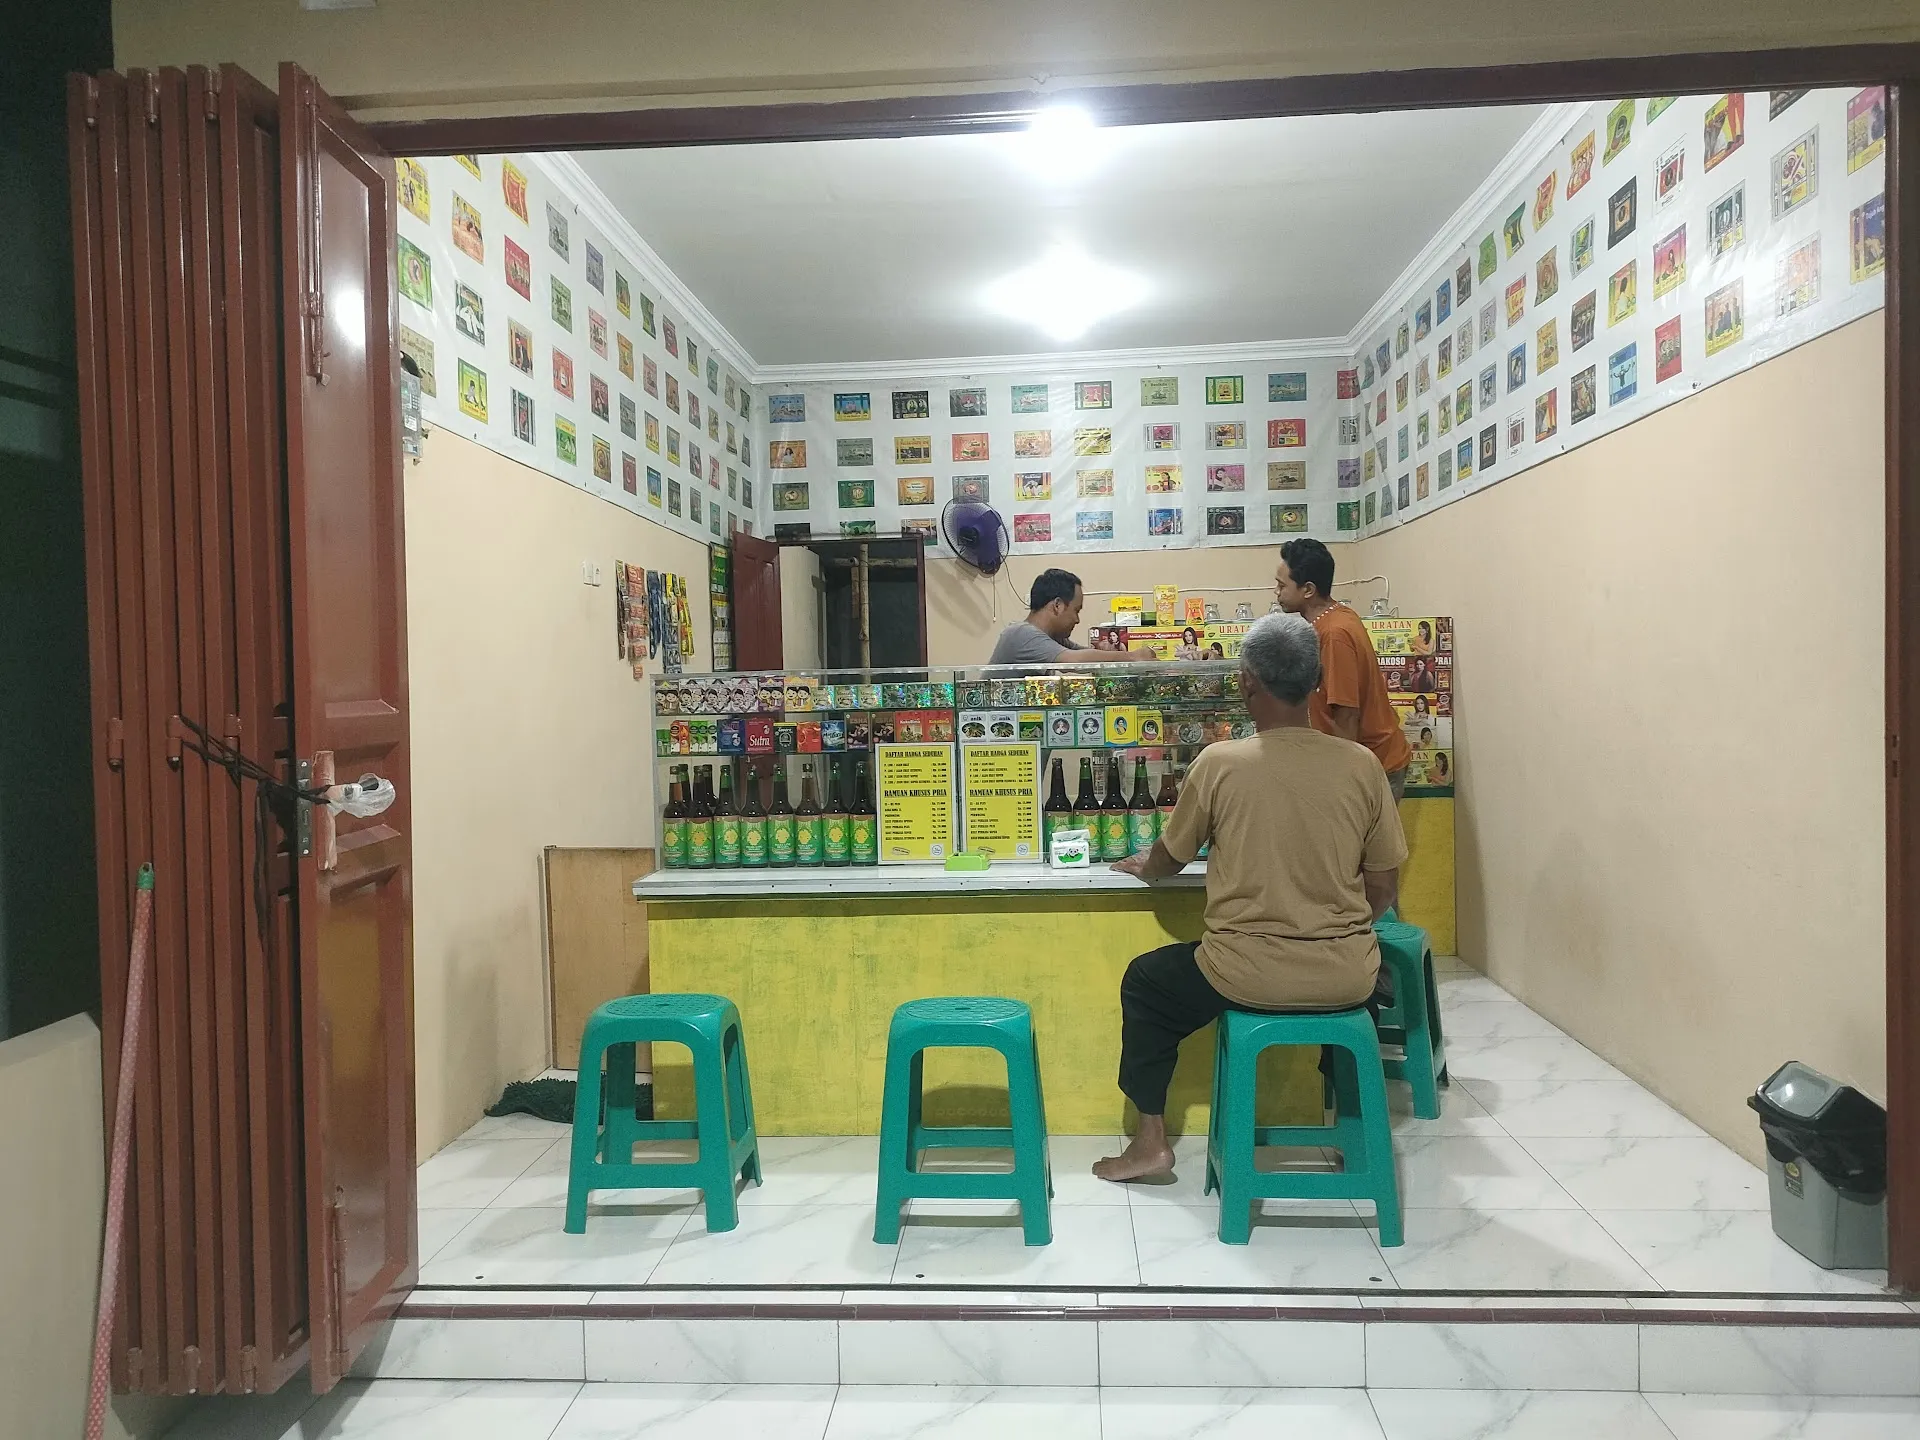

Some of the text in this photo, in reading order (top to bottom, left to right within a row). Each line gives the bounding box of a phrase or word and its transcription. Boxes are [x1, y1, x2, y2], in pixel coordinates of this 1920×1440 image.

[1372, 621, 1412, 629] URATAN
[749, 734, 770, 747] Sutra
[969, 788, 1033, 797] RAMUAN KHUSUS PRIA
